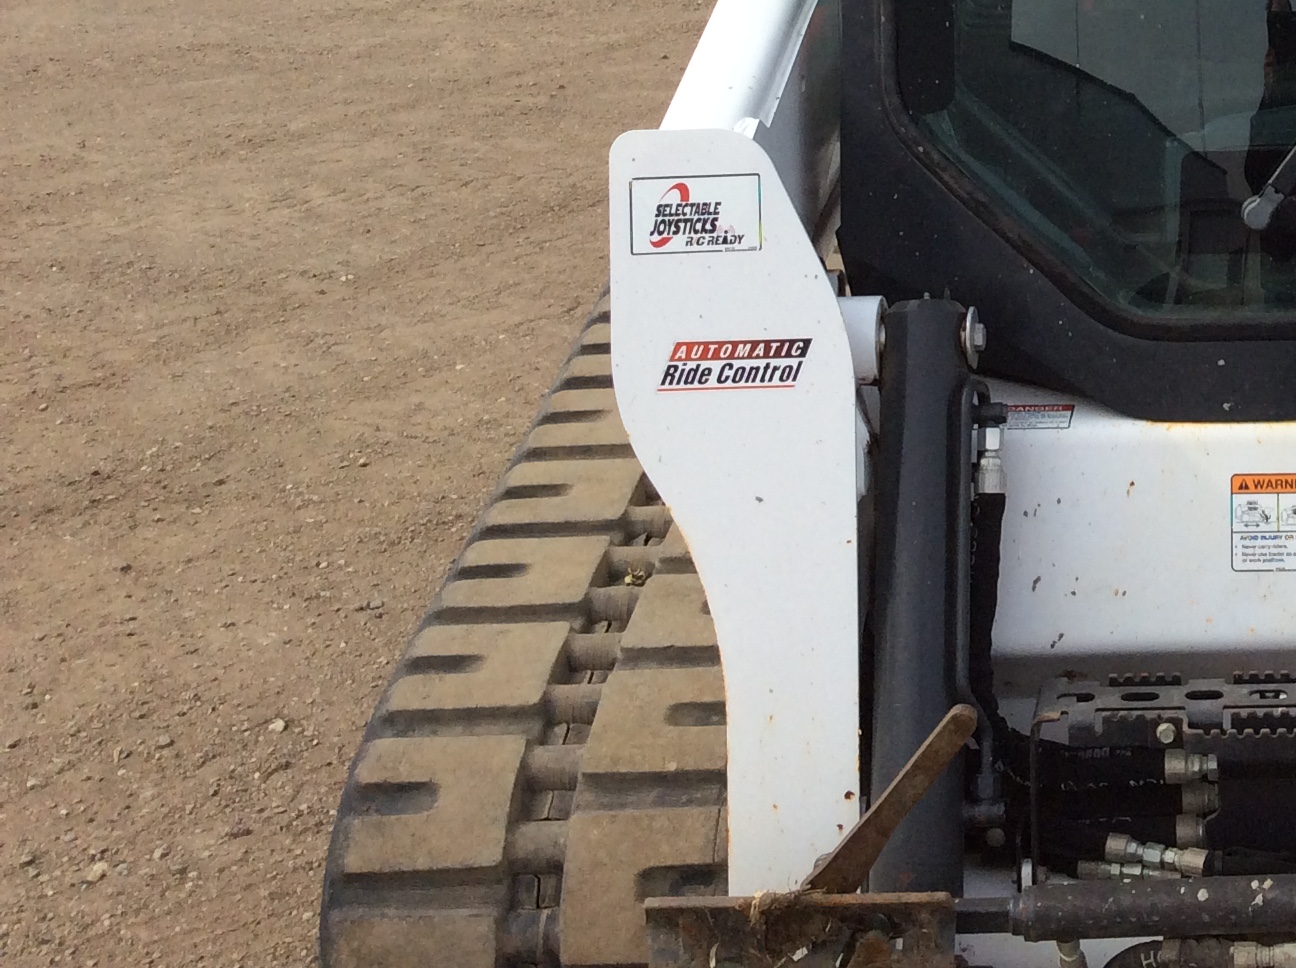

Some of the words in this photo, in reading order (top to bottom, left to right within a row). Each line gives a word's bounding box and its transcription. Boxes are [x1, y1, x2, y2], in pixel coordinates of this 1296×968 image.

[654, 201, 722, 218] SELECTABLE
[649, 217, 719, 237] JOYSTICKS
[706, 234, 746, 246] READY
[674, 341, 805, 360] AUTOMATIC
[660, 363, 713, 386] Ride
[716, 361, 804, 385] Control
